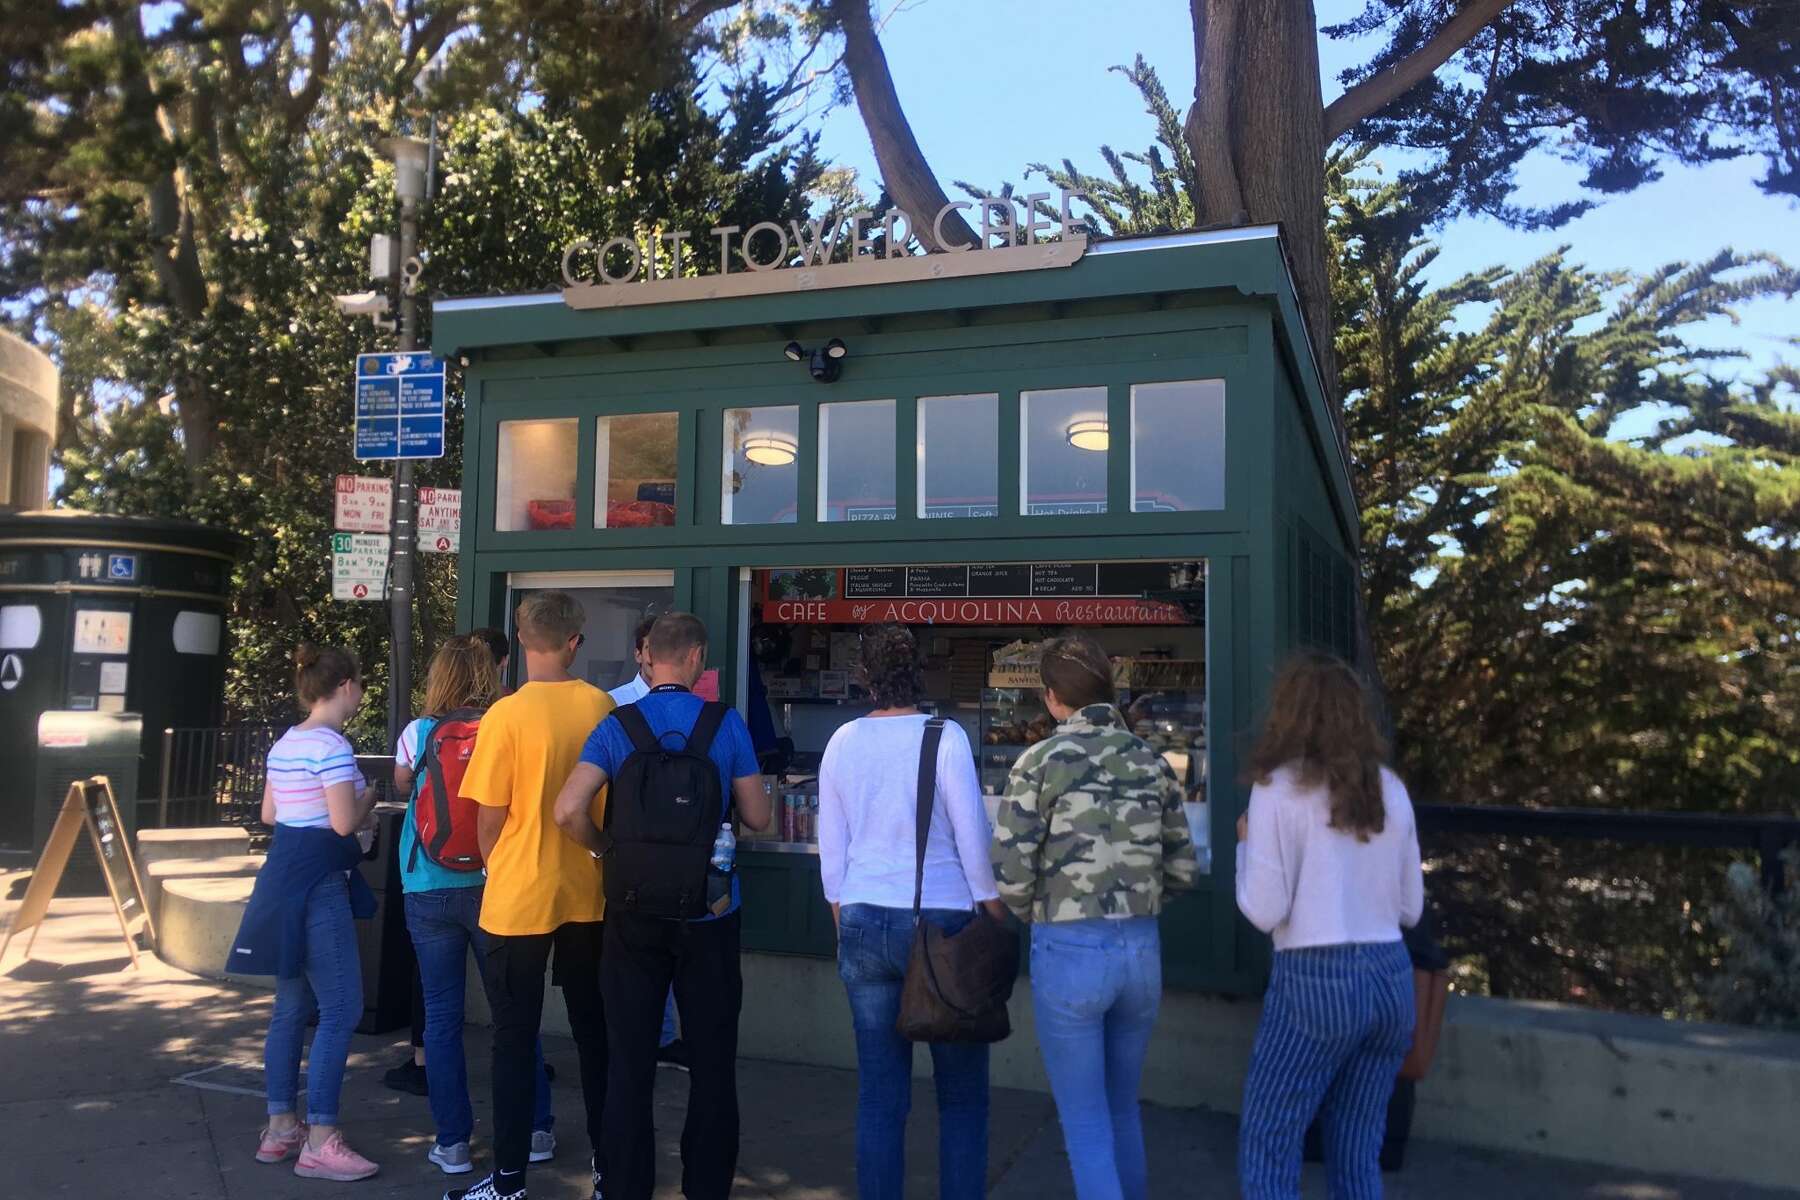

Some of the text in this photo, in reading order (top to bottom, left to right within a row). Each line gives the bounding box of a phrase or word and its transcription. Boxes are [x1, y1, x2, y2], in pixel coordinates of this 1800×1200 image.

[561, 189, 1088, 288] COIT TOWER CAFE
[338, 478, 389, 494] NO PARKING
[420, 490, 435, 504] NO
[336, 536, 352, 552] 30
[353, 547, 388, 555] PARKING
[778, 603, 826, 621] CAFE
[884, 601, 1043, 622] ACQUOLINA
[1055, 601, 1175, 622] Restaurant
